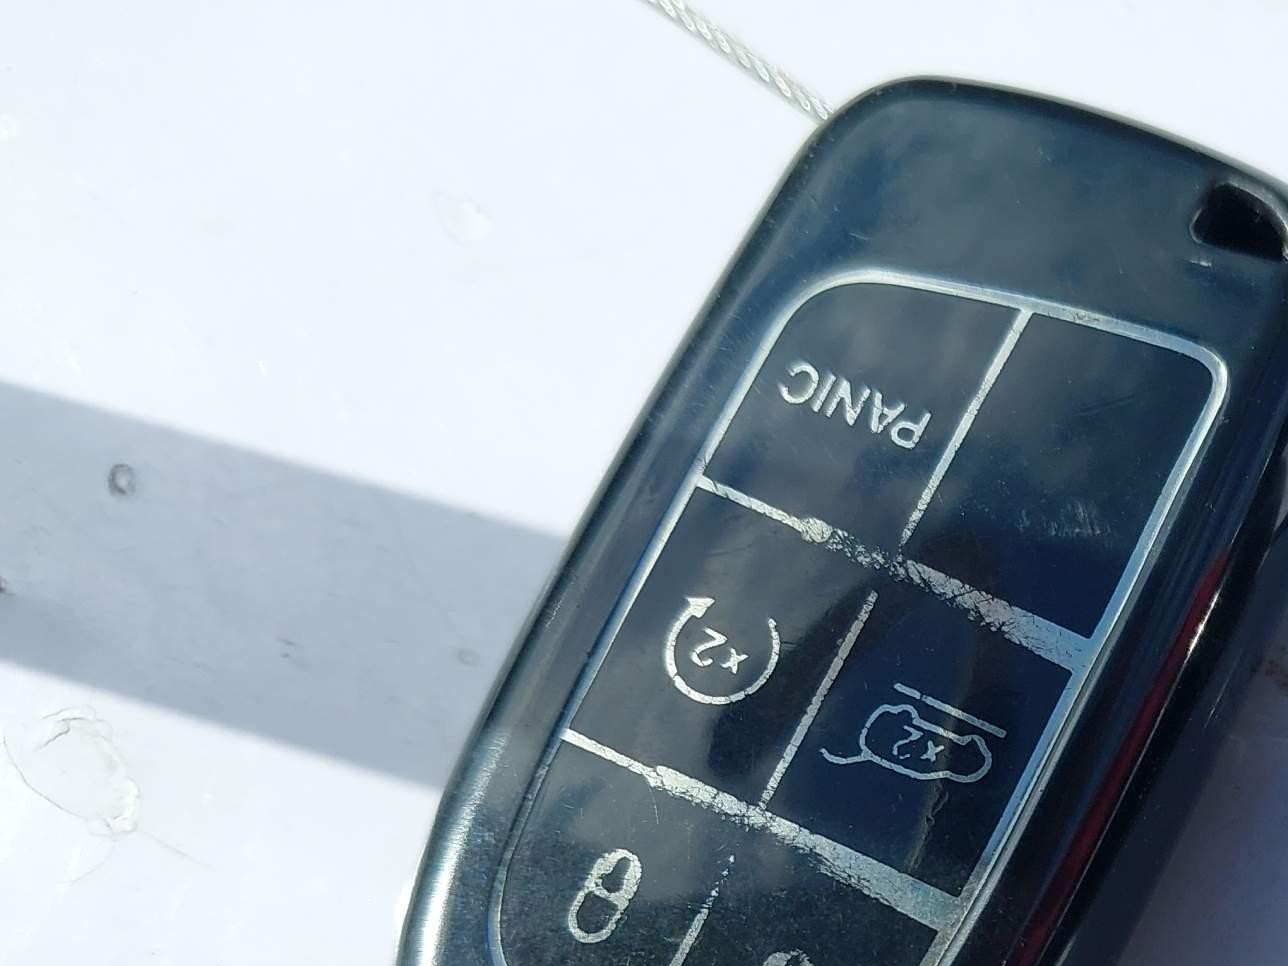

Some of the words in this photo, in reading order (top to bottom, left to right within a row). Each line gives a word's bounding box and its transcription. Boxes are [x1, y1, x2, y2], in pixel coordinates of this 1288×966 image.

[778, 360, 932, 449] PANIC
[690, 626, 749, 674] x2
[892, 724, 945, 763] x2
